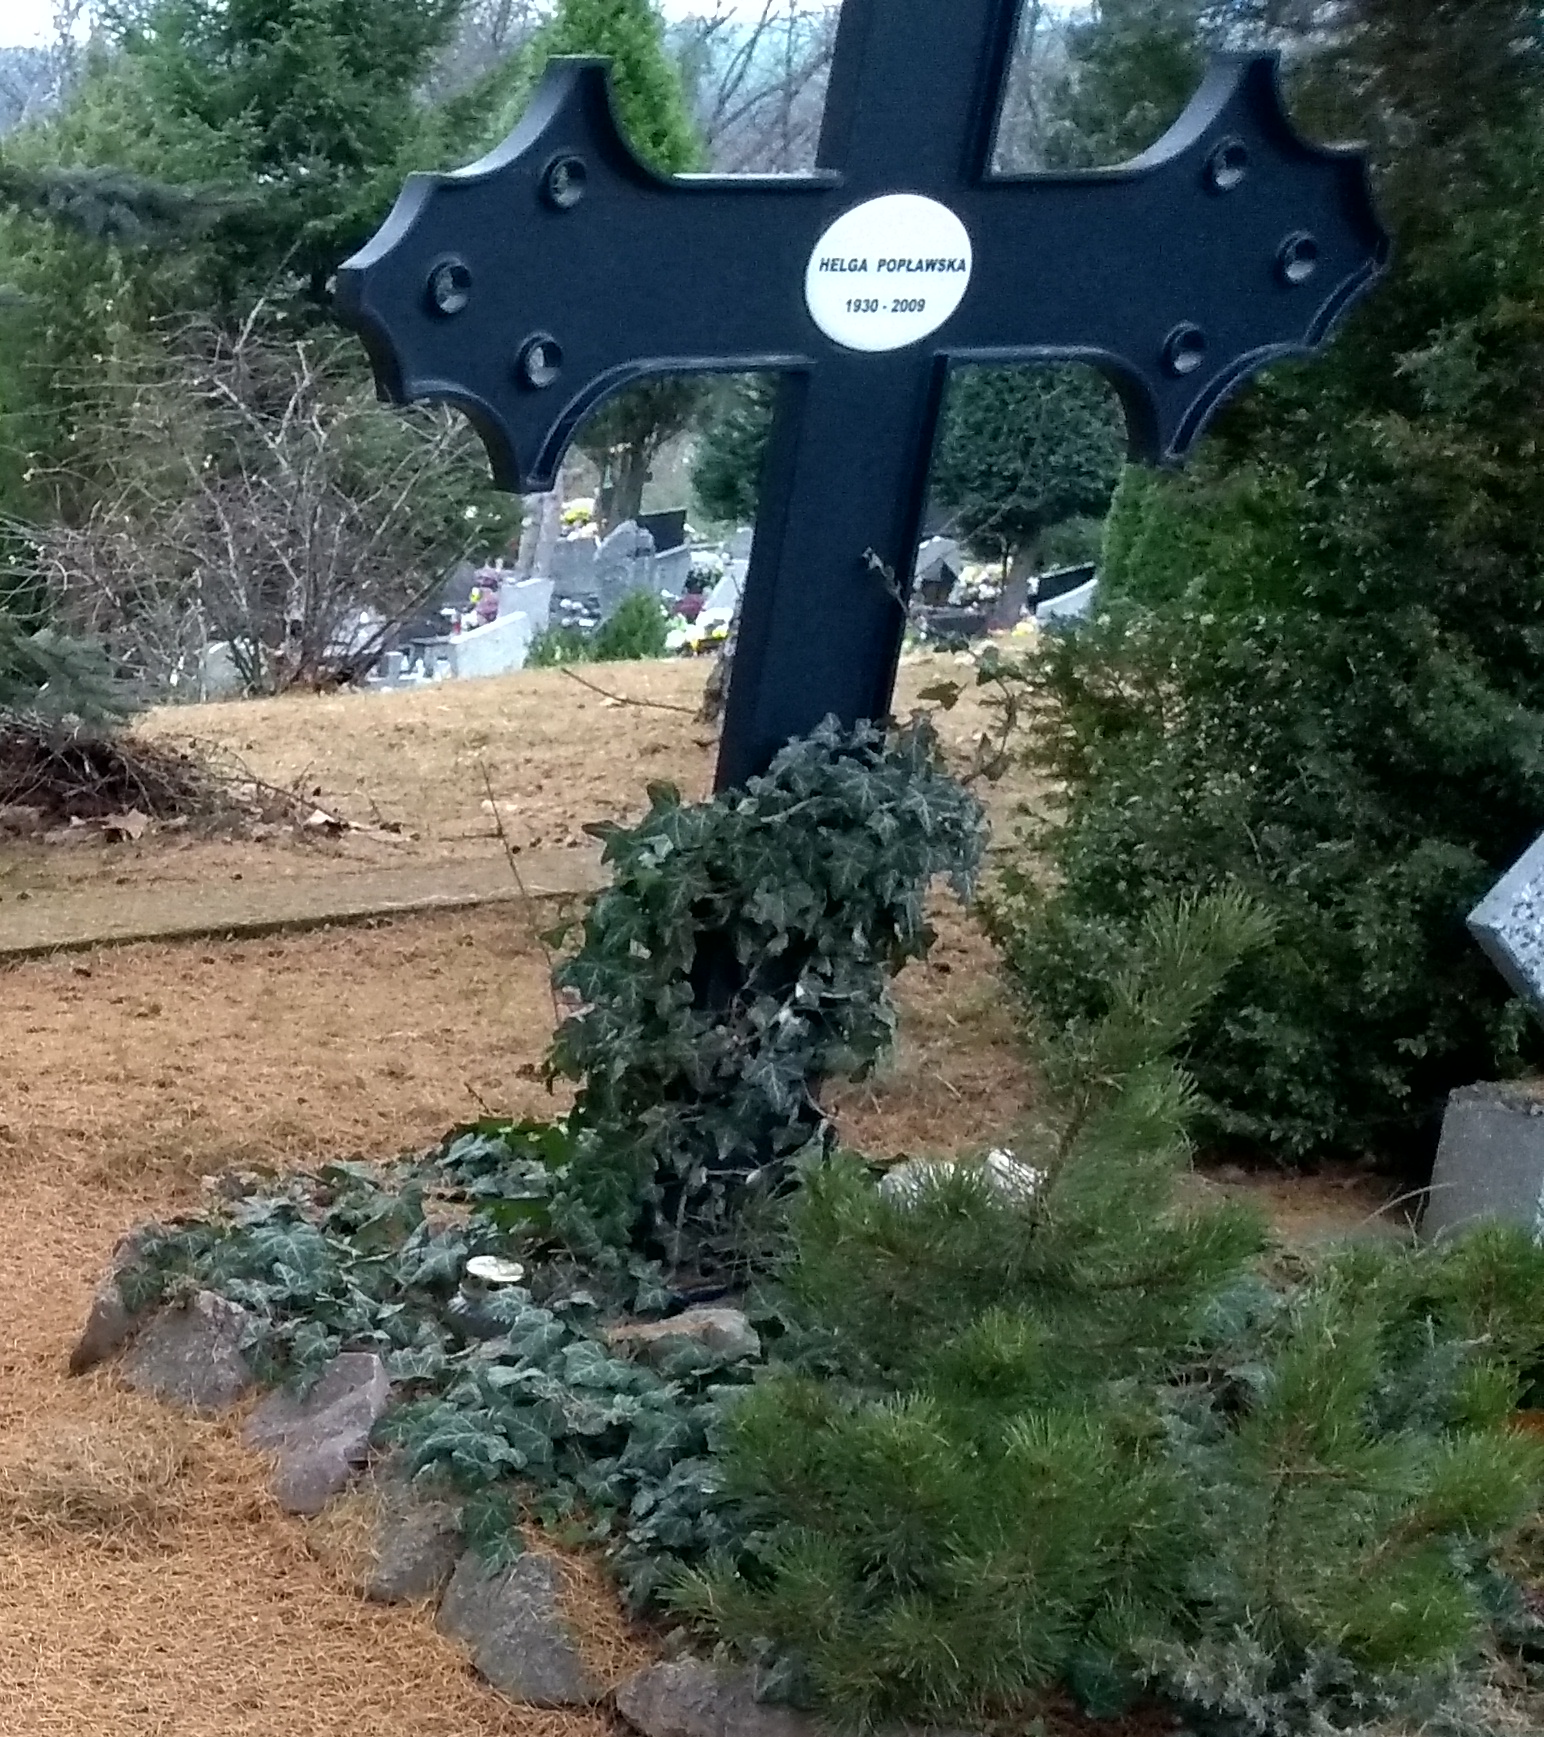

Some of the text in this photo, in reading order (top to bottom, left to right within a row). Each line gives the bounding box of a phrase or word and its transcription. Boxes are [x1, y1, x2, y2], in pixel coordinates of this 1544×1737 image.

[819, 258, 966, 273] HELGA POPŁAWSKA
[845, 299, 879, 313] 1930
[891, 299, 926, 313] 2009
